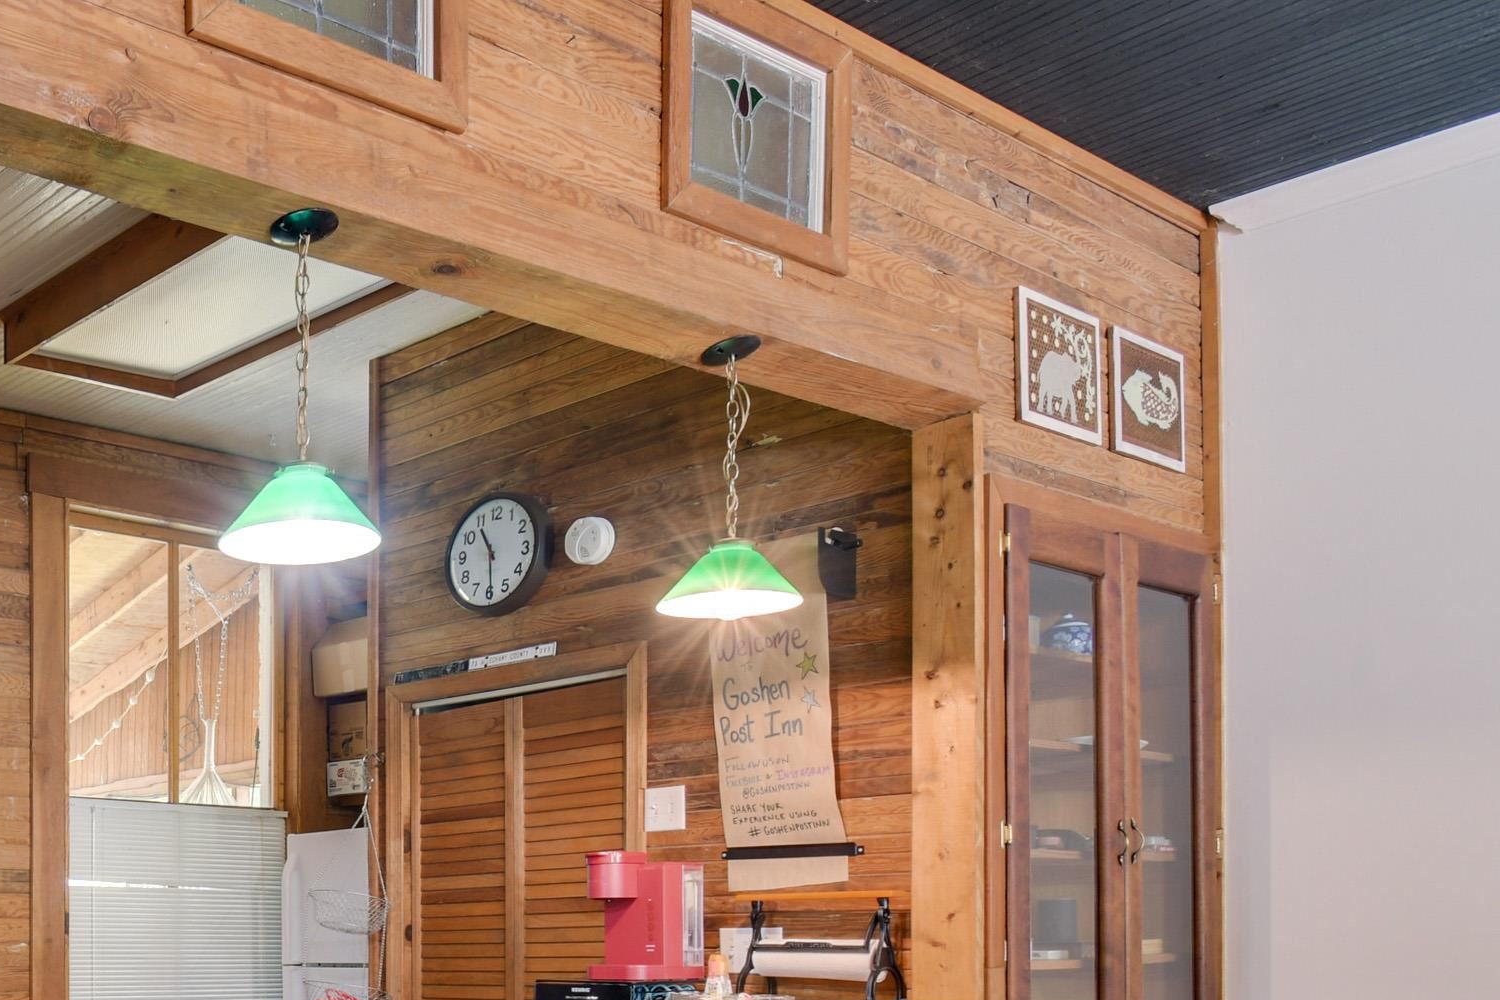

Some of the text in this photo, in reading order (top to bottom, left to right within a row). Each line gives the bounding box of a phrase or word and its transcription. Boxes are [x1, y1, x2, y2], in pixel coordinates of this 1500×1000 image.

[476, 513, 485, 527] 11
[491, 506, 502, 520] 12
[509, 506, 514, 520] 1
[518, 520, 527, 534] 2
[463, 531, 476, 545] 10
[521, 540, 530, 555] 3
[459, 551, 467, 565] 9
[514, 562, 523, 576] 4
[461, 570, 470, 584] 8
[472, 583, 480, 596] 7
[485, 585, 494, 600] 6
[501, 578, 510, 593] 5
[716, 627, 809, 662] Welcome
[722, 676, 791, 711] Goshen
[719, 710, 803, 746] Post Inn
[731, 802, 783, 815] SHARE YOUR
[732, 809, 818, 825] EXPERIENCE USING
